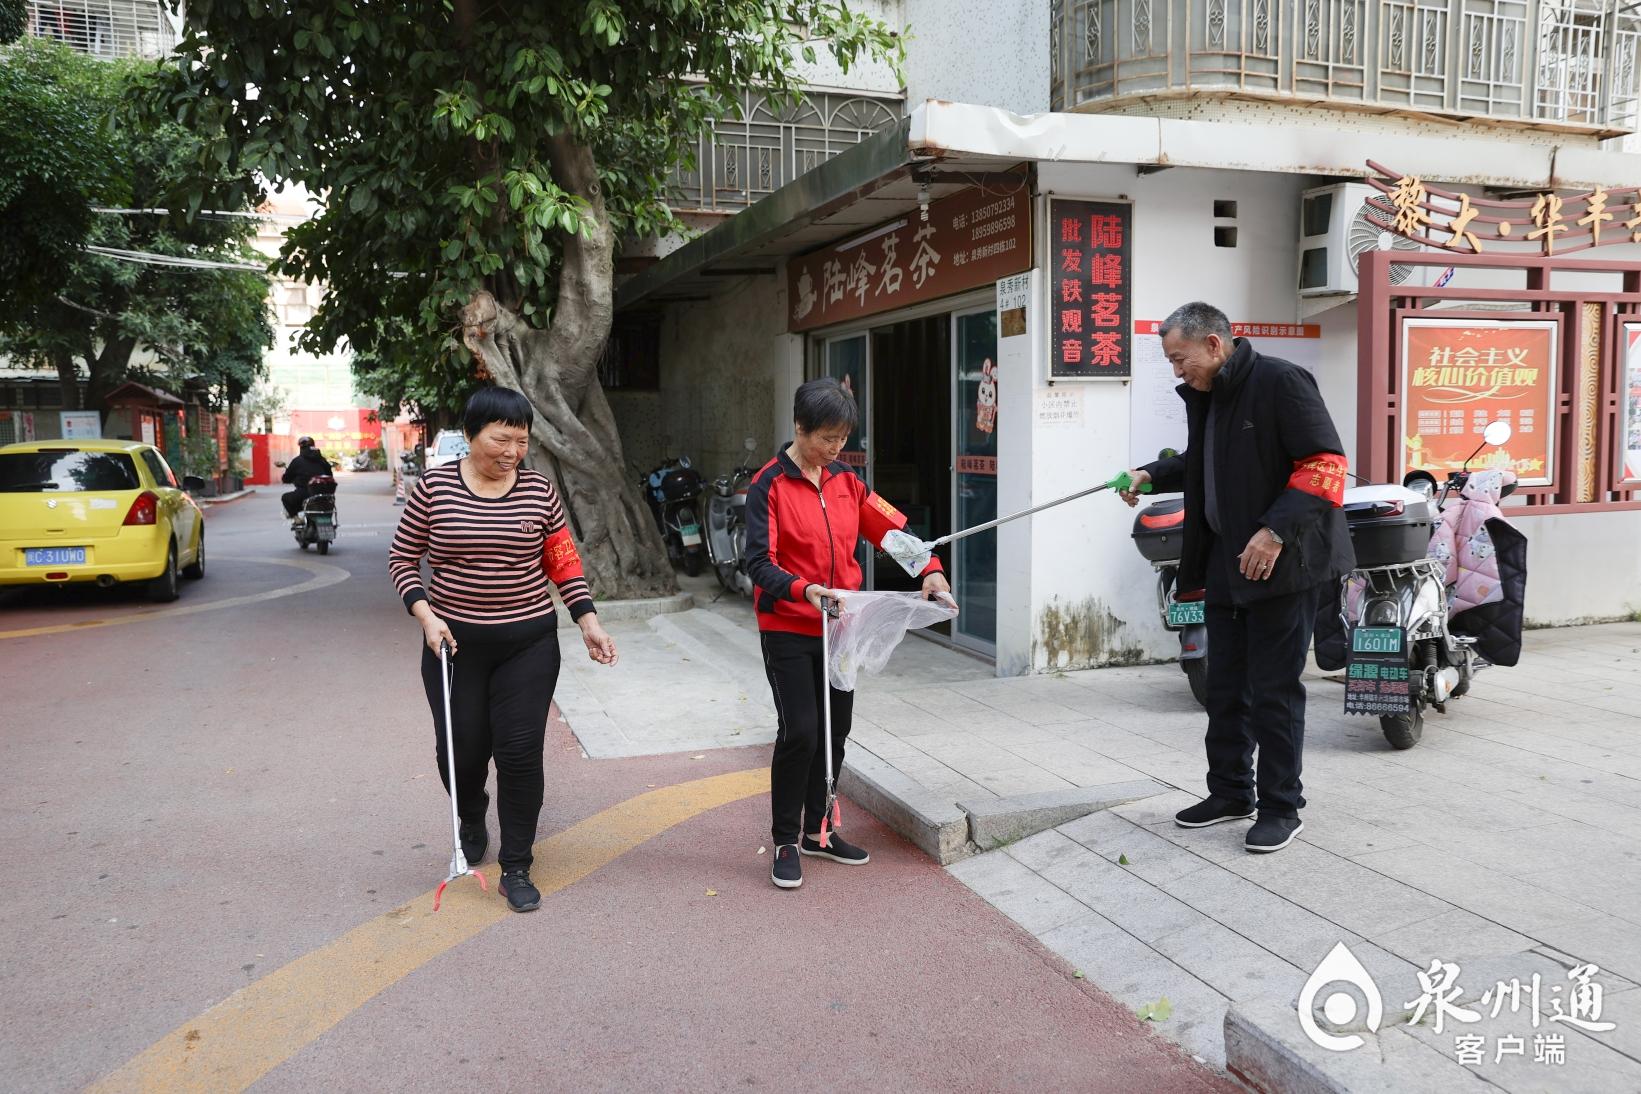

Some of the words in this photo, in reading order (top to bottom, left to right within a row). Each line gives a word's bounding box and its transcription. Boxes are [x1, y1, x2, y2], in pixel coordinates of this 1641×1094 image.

[1387, 175, 1641, 257] 黎大·华丰
[822, 223, 942, 314] 陆峰茗茶
[1061, 217, 1084, 365] 批发铁观音
[1091, 214, 1123, 367] 陆峰茗茶
[1014, 294, 1026, 309] 102
[1411, 366, 1539, 387] 核心价值观
[1428, 346, 1529, 367] 社会主义
[1349, 663, 1379, 679] 绿源
[1380, 667, 1408, 681] 电动车
